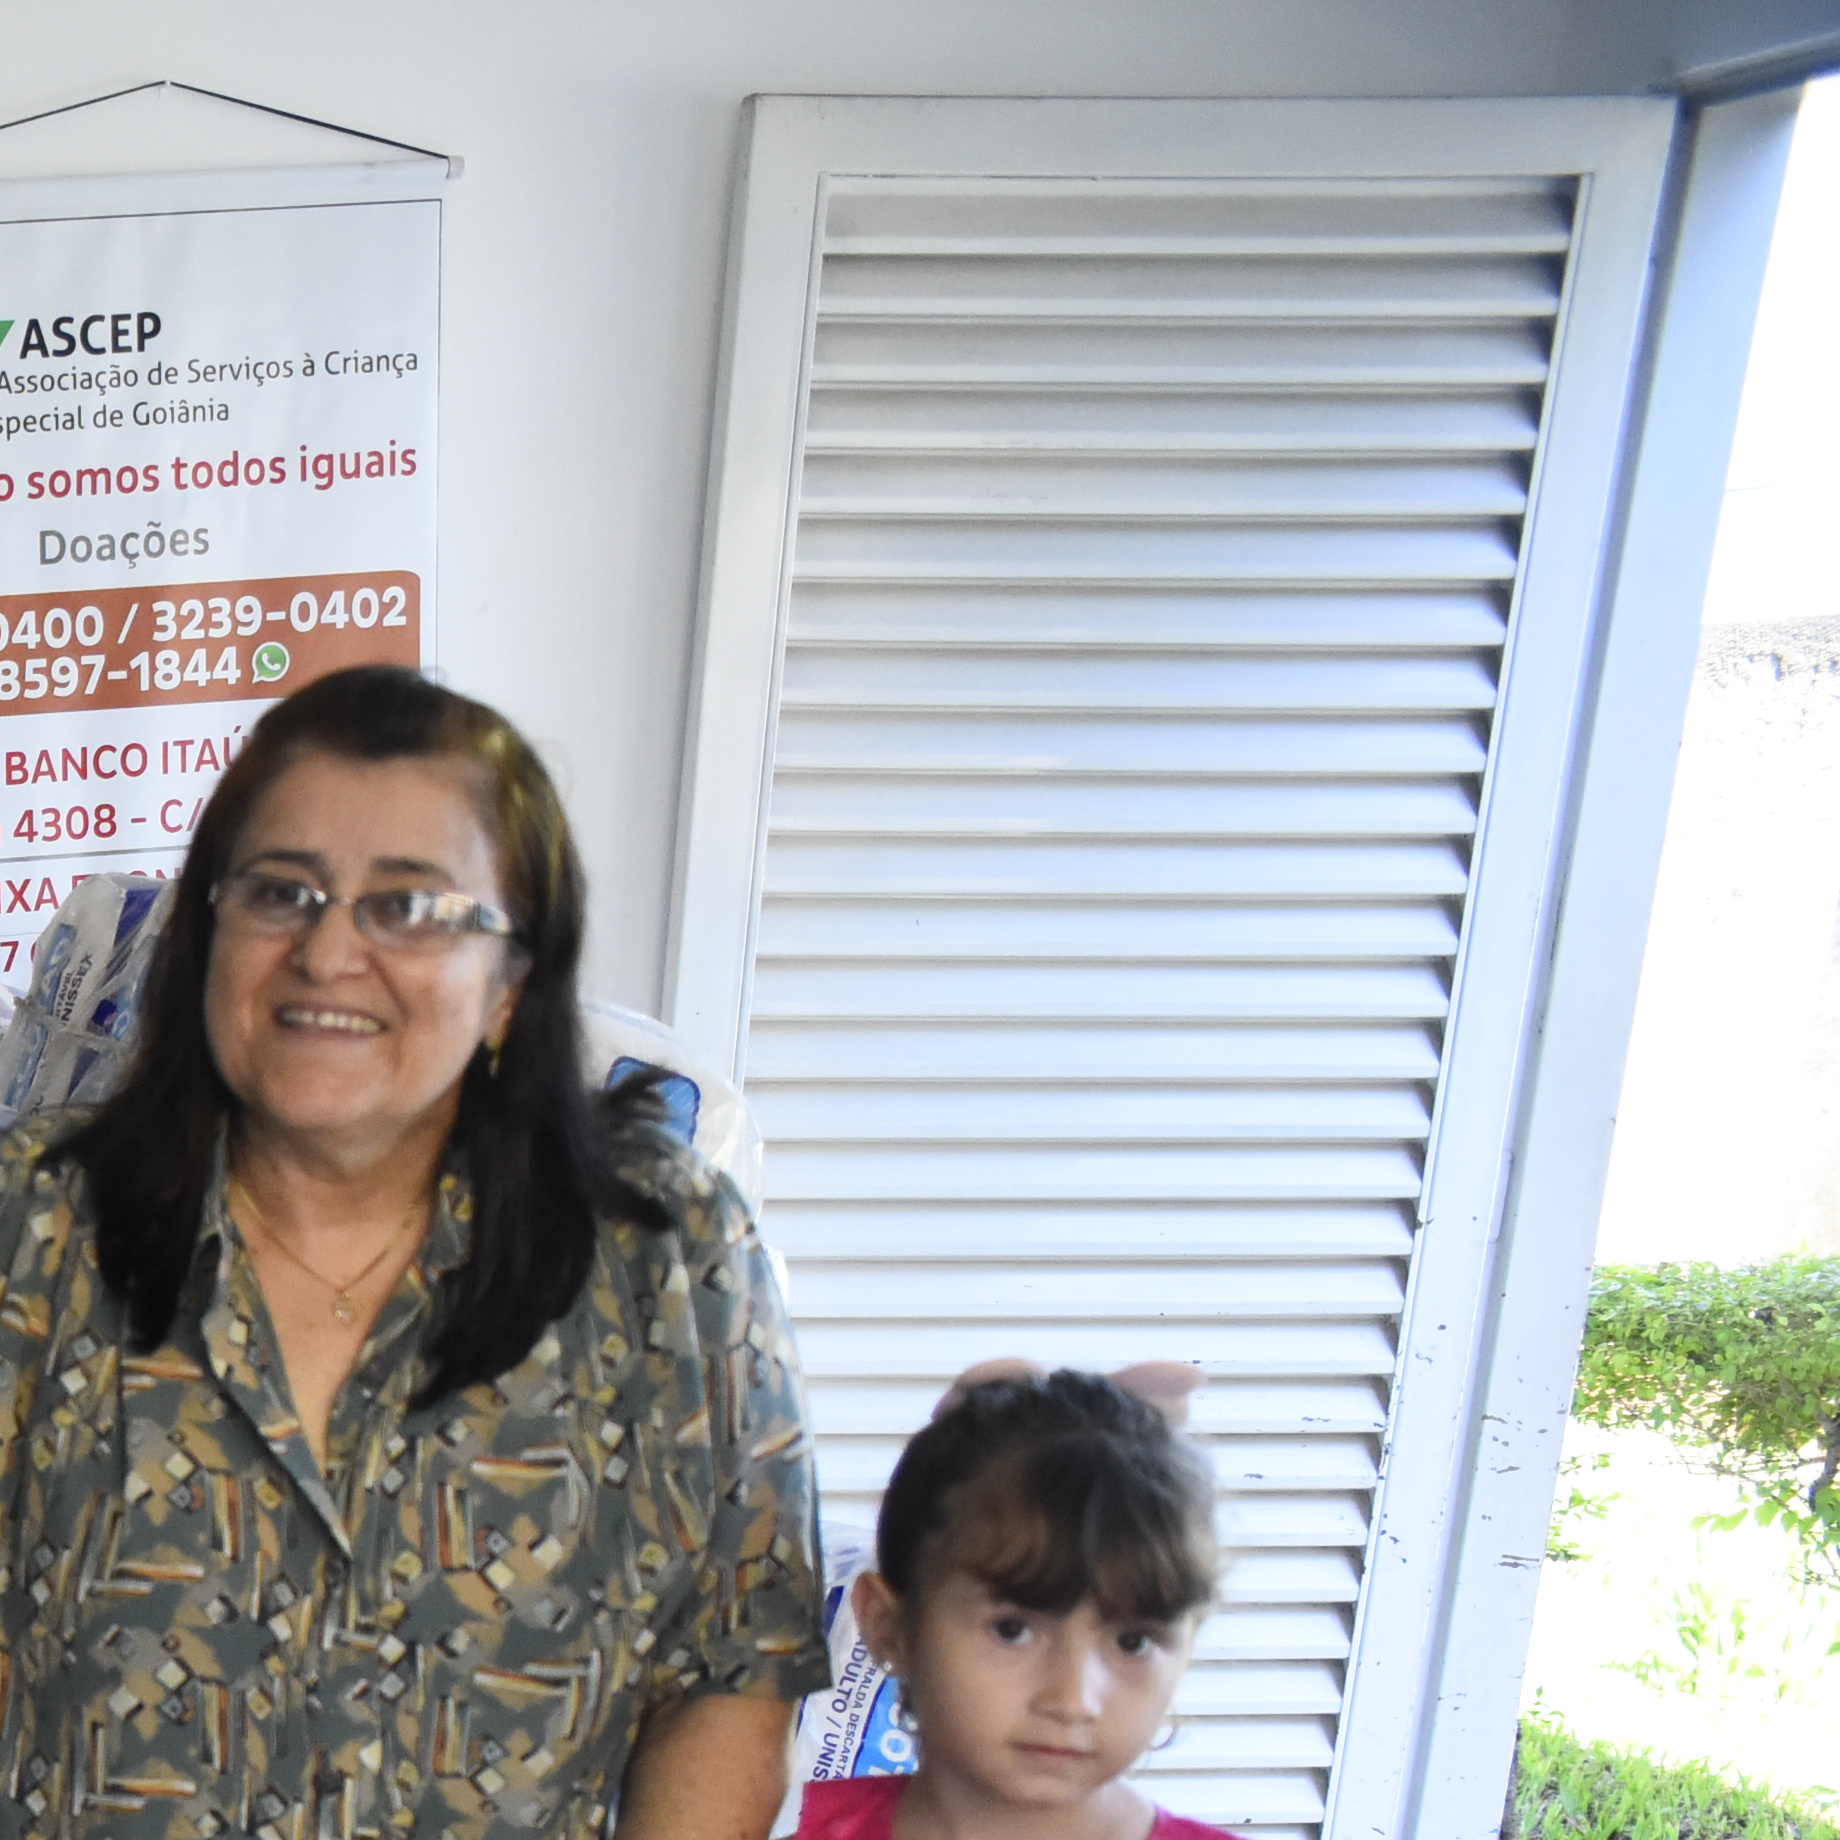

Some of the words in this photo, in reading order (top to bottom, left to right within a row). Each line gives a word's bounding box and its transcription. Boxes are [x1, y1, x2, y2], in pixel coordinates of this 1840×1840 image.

[19, 311, 163, 360] ASCEP
[147, 359, 179, 388] de
[188, 353, 294, 388] Serviços
[303, 350, 316, 378] à
[324, 345, 419, 378] Criança
[92, 402, 124, 429] de
[132, 397, 230, 428] Goiânia
[27, 459, 159, 500] somos
[171, 450, 287, 491] todos
[299, 439, 418, 492] iguais
[39, 522, 210, 568] Doações
[116, 602, 139, 644] /
[152, 585, 407, 643] 3239-0402
[5, 742, 149, 786] BANCO
[13, 804, 117, 843] 4308
